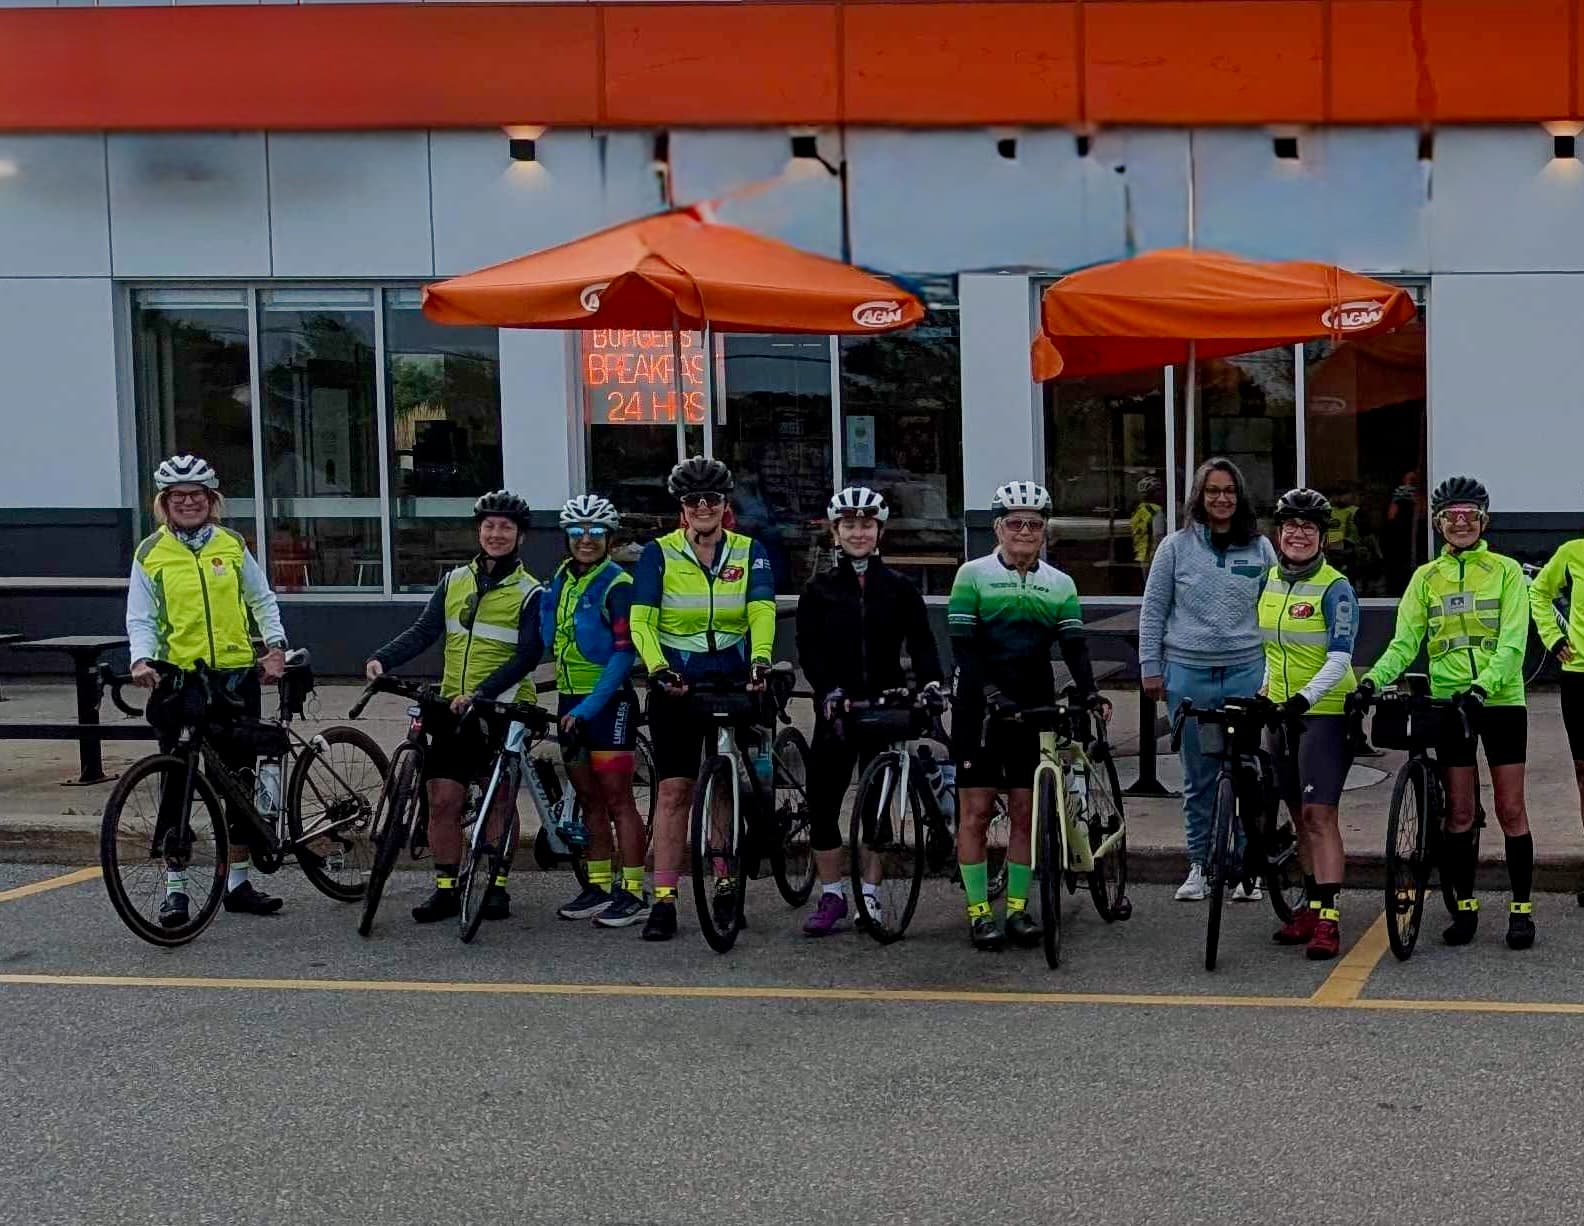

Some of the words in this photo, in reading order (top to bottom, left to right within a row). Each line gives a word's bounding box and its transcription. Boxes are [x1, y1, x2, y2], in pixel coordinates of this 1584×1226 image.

[588, 352, 704, 385] BREAKFAS
[608, 391, 643, 421] 24
[652, 391, 704, 421] HRS
